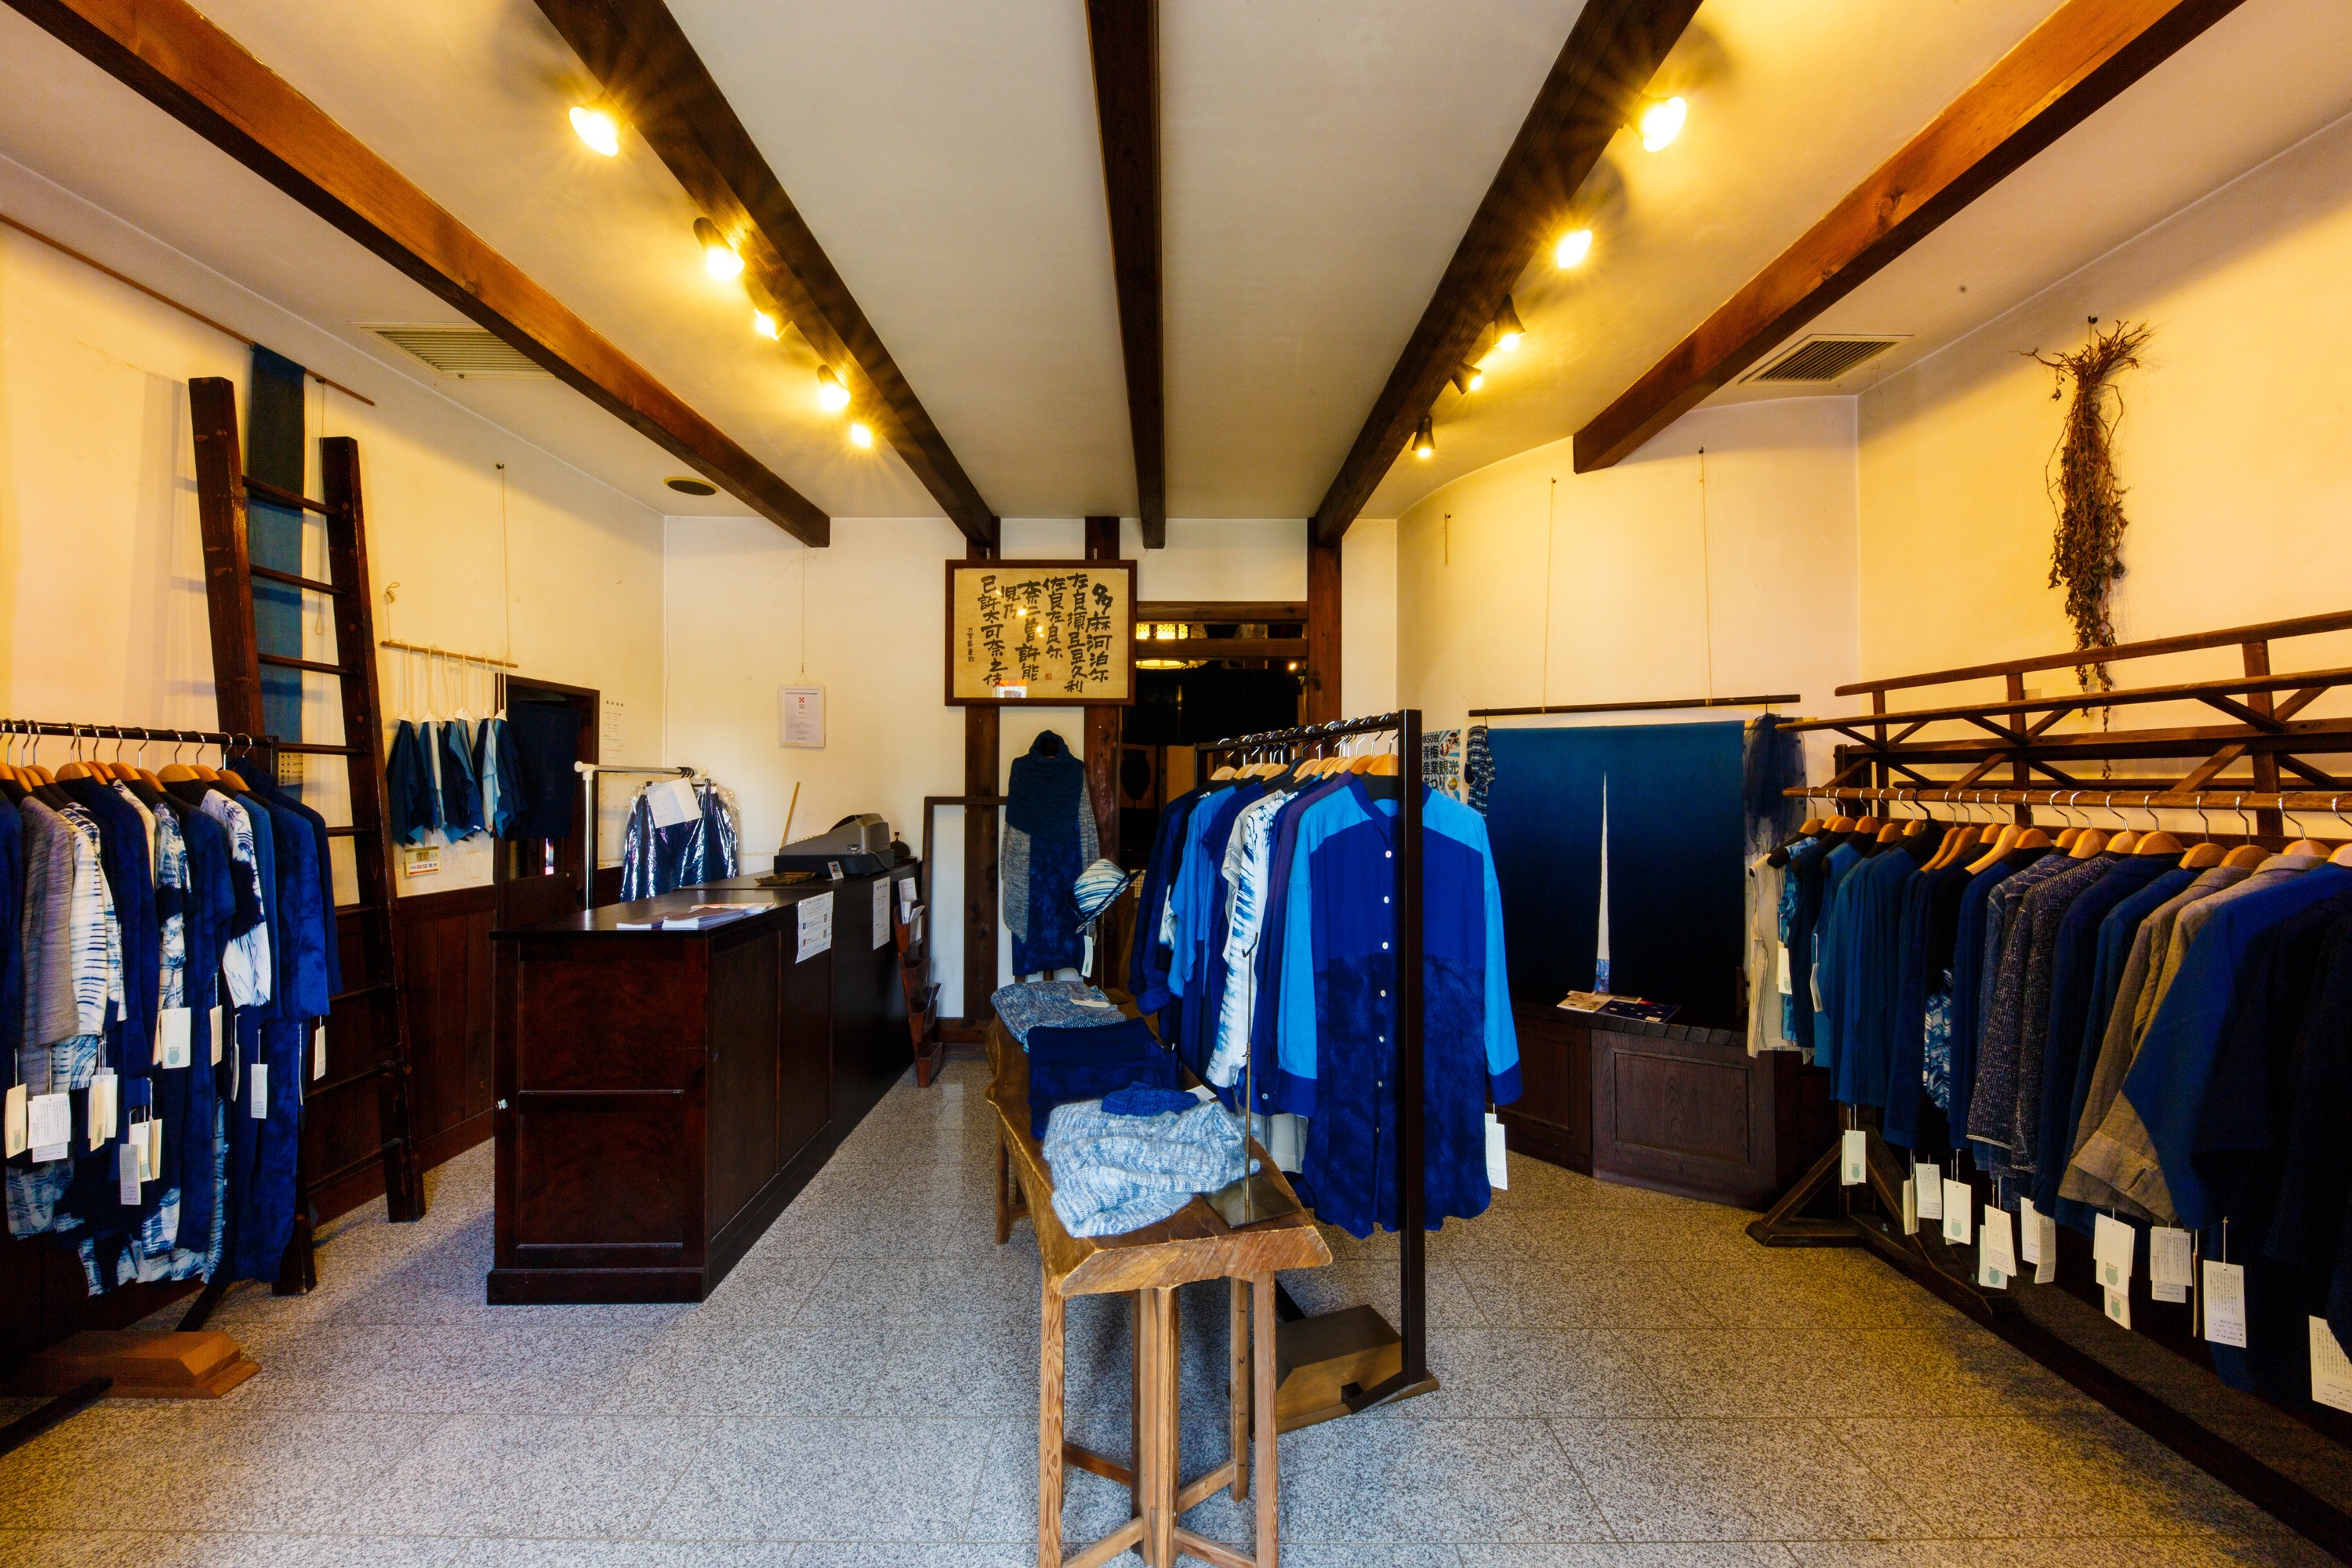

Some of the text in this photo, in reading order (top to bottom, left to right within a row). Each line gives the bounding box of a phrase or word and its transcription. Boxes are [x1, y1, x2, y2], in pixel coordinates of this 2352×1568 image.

[1423, 745, 1439, 760] 青梅
[1423, 760, 1460, 775] 産業観光
